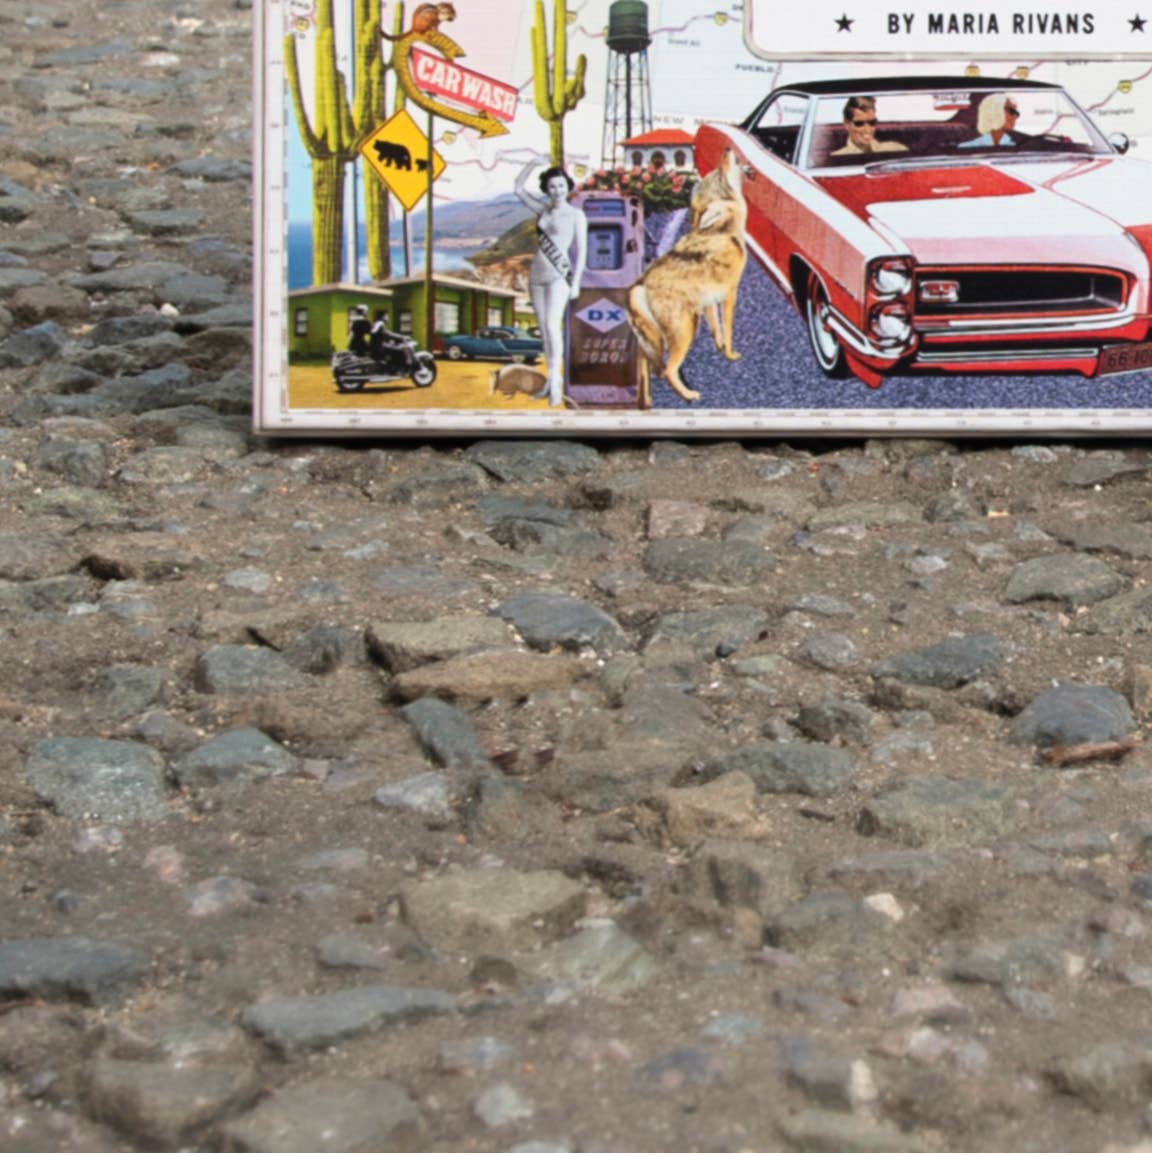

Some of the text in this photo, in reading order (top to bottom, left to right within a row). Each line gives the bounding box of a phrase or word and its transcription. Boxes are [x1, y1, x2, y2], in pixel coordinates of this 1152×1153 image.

[887, 12, 1095, 35] BY MARIA RIVANS
[417, 55, 515, 119] CAR WASH
[586, 309, 622, 322] DX
